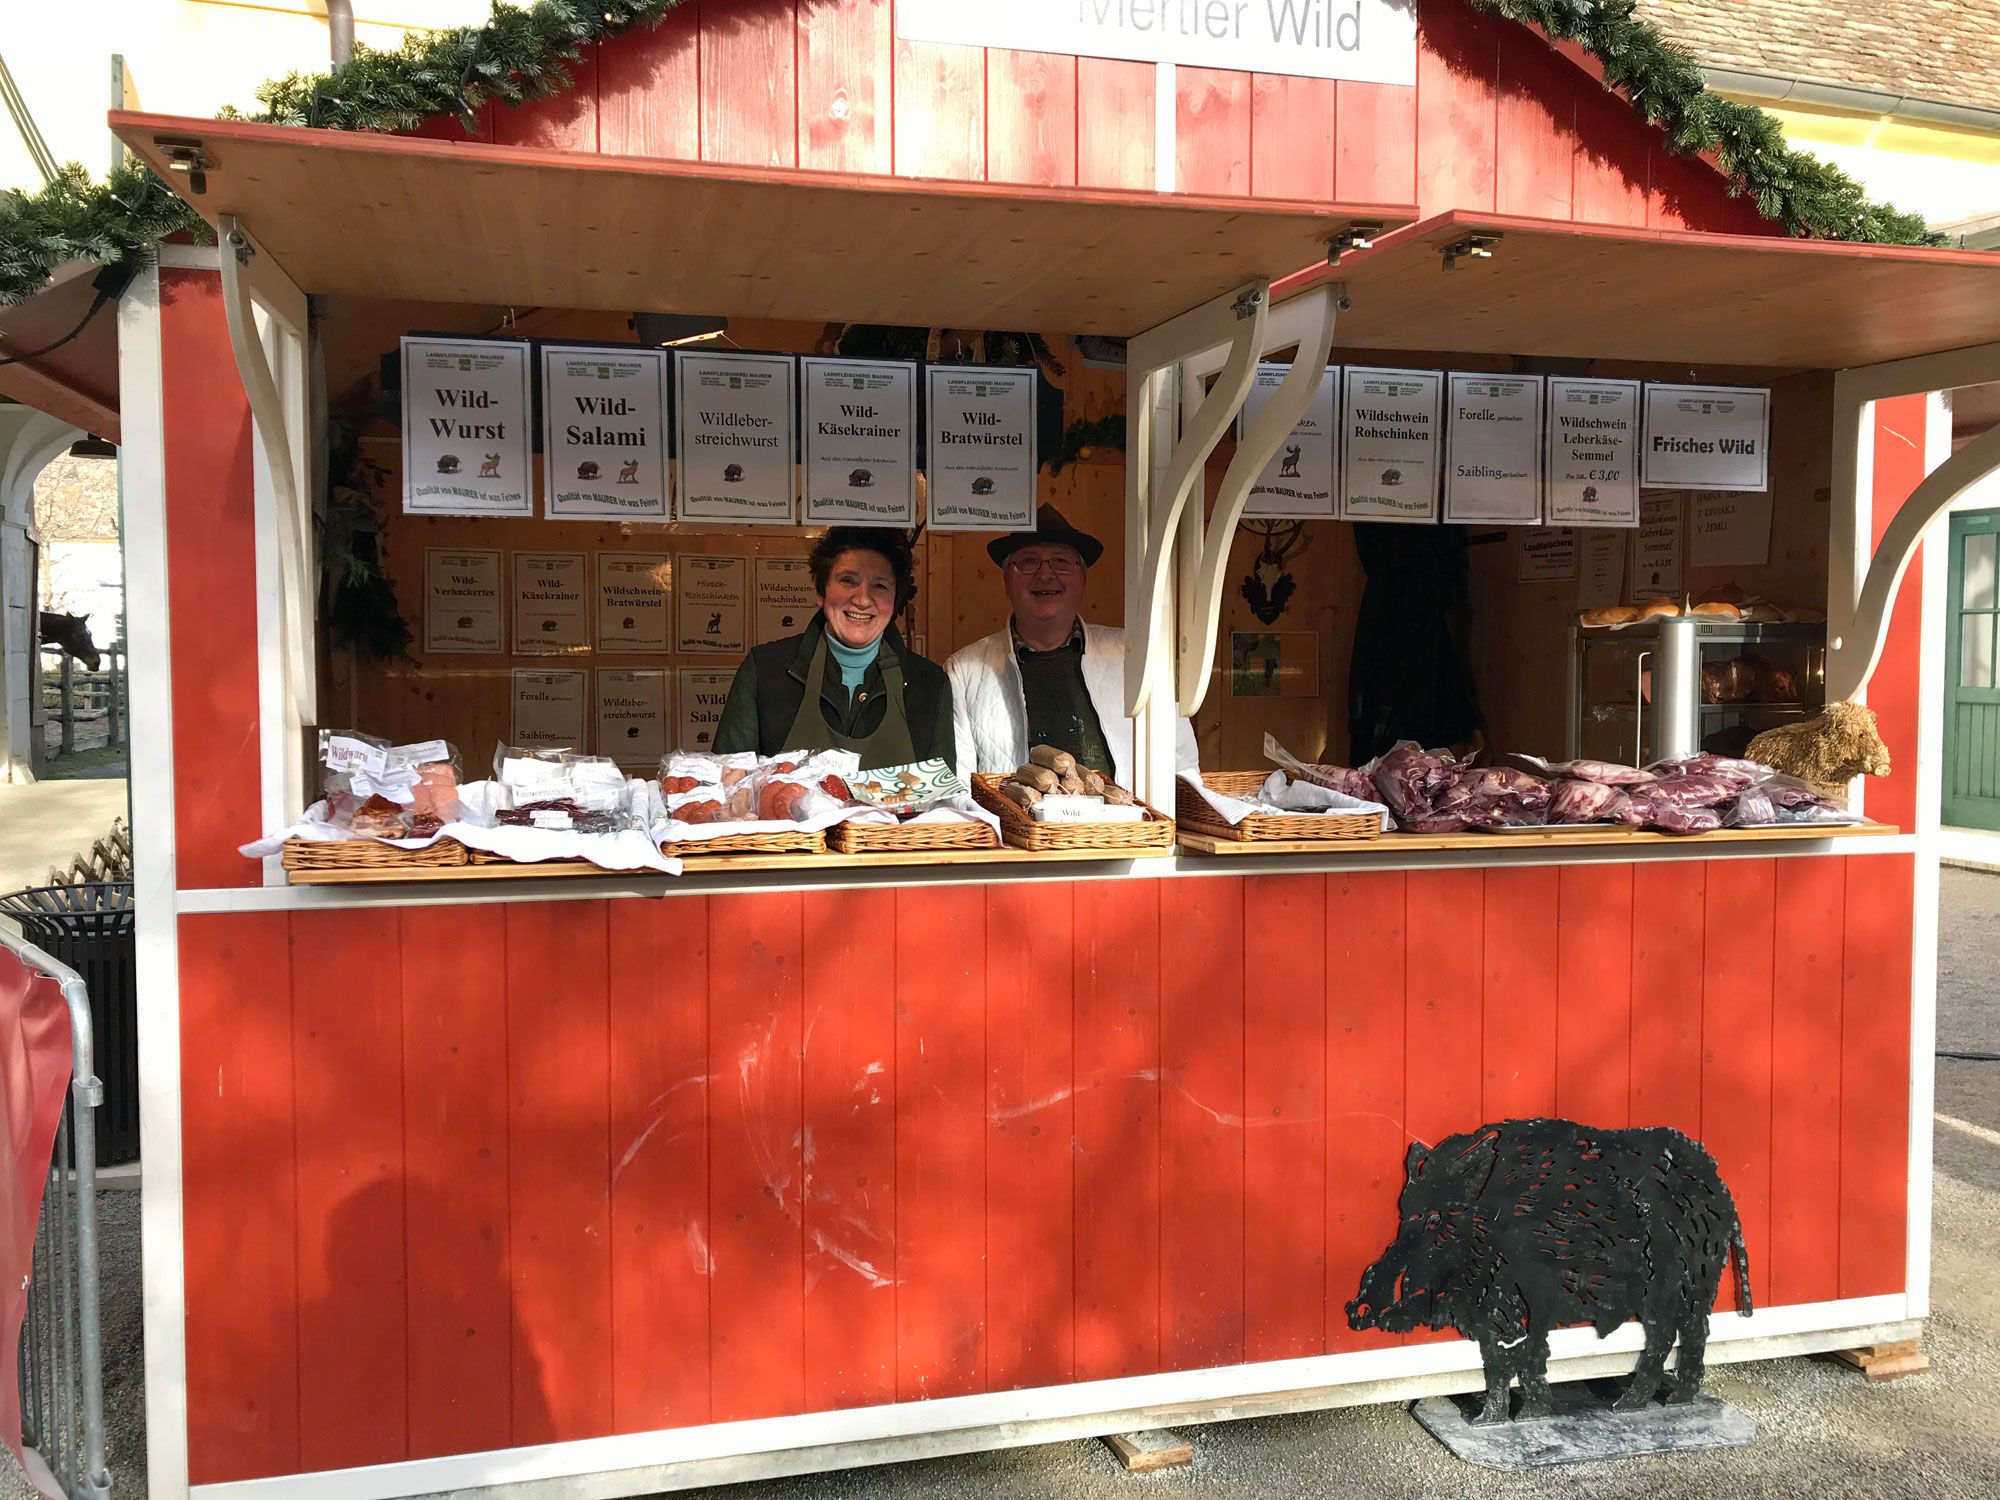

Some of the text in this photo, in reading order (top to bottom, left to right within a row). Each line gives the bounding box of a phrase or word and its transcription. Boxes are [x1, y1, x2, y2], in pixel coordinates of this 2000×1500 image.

[1267, 0, 1361, 51] Wild
[435, 389, 498, 408] Wild-
[574, 397, 636, 416] Wild-
[840, 404, 878, 418] Wild-
[699, 412, 773, 427] Wildleber-
[962, 412, 1002, 425] Wild-
[1356, 409, 1429, 424] Wildschwein
[1459, 407, 1496, 421] Forelle
[429, 418, 506, 440] Wurst
[1560, 416, 1627, 430] Wildschwein
[566, 425, 646, 446] Salami
[817, 422, 901, 438] Käsekrainer
[1355, 426, 1429, 440] Rohschinken
[695, 433, 779, 447] streichwurst
[941, 431, 1022, 446] Bratwürstel
[1564, 433, 1623, 446] Leberkäse-
[1653, 436, 1755, 455] Frisches Wild
[1572, 450, 1614, 461] Semmel
[1457, 465, 1502, 479] Saibling
[1589, 470, 1597, 480] €
[1598, 470, 1620, 482] 3,00
[416, 485, 439, 497] Qualität
[452, 487, 478, 499] MAURER
[1275, 487, 1296, 498] MAURER
[1314, 491, 1329, 500] Feines
[557, 491, 580, 503] Qualität
[582, 493, 592, 501] von
[594, 493, 618, 505] MAURER
[618, 497, 626, 506] ist
[640, 499, 658, 508] Feines
[723, 497, 748, 506] MAURER
[813, 497, 834, 508] Qualität
[845, 498, 869, 510] MAURER
[888, 504, 905, 513] Feines
[1350, 495, 1368, 504] Qualität
[1377, 496, 1396, 507] MAURER
[1414, 502, 1429, 510] Feines
[937, 506, 958, 516] Qualität
[968, 506, 990, 518] MAURER
[1009, 511, 1026, 520] Feines
[451, 576, 479, 585] Wild-
[537, 580, 564, 588] Wild-
[434, 587, 495, 597] Verhackertes
[602, 586, 665, 596] Wildschwein-
[760, 583, 815, 592] Wildschwein-
[522, 591, 580, 600] Käsekrainer
[684, 592, 740, 600] Rohschinken
[760, 595, 807, 603] rohschinken
[607, 598, 661, 607] Bratwürstel
[520, 691, 550, 700] Forelle
[696, 694, 726, 705] Wild
[603, 698, 648, 707] Wildleber-
[603, 711, 656, 719] streichwurst
[690, 710, 719, 723] Sala
[519, 730, 556, 741] Saibling
